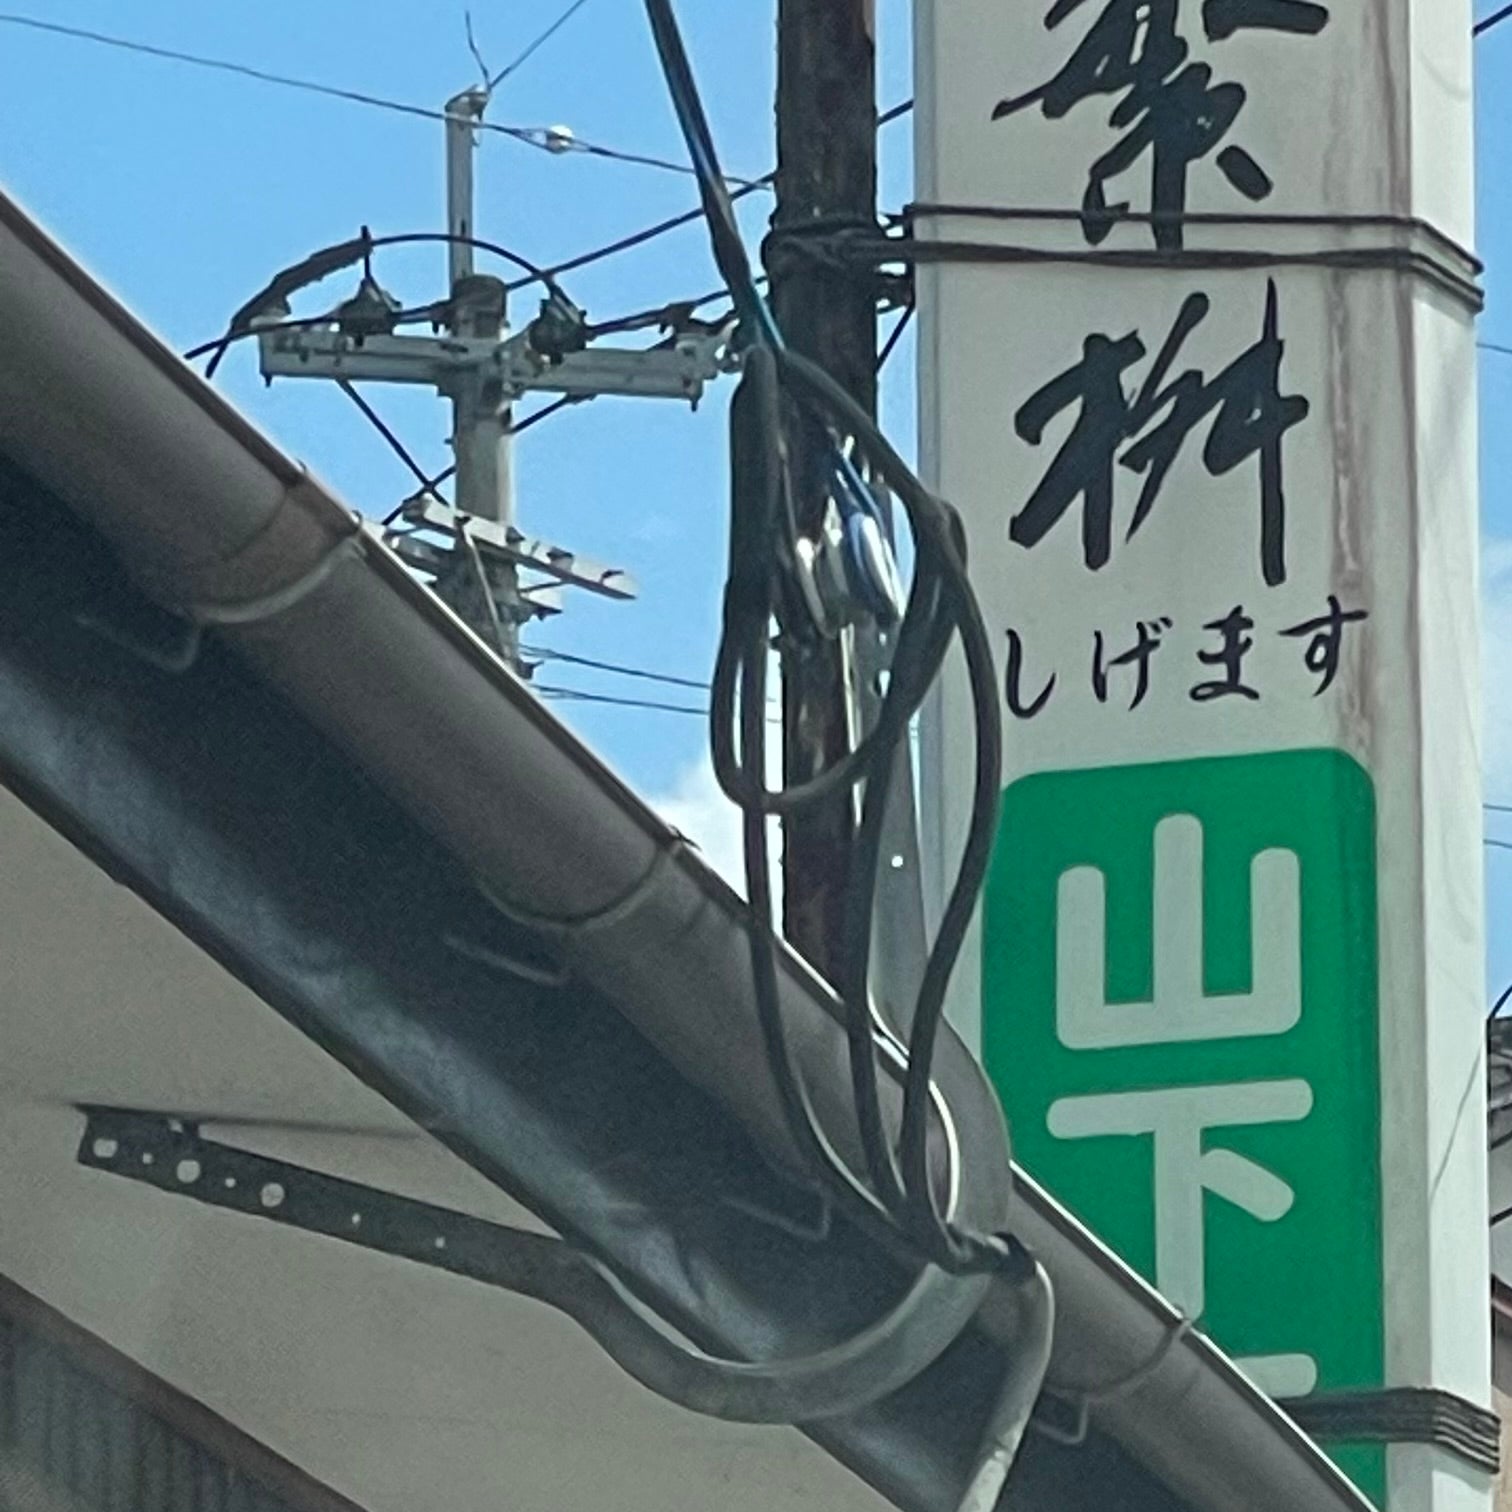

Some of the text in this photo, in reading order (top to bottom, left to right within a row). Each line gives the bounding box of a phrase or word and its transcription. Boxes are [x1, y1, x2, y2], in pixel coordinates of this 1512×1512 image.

[1004, 595, 1370, 719] しげます
[1046, 812, 1318, 1398] 山下
